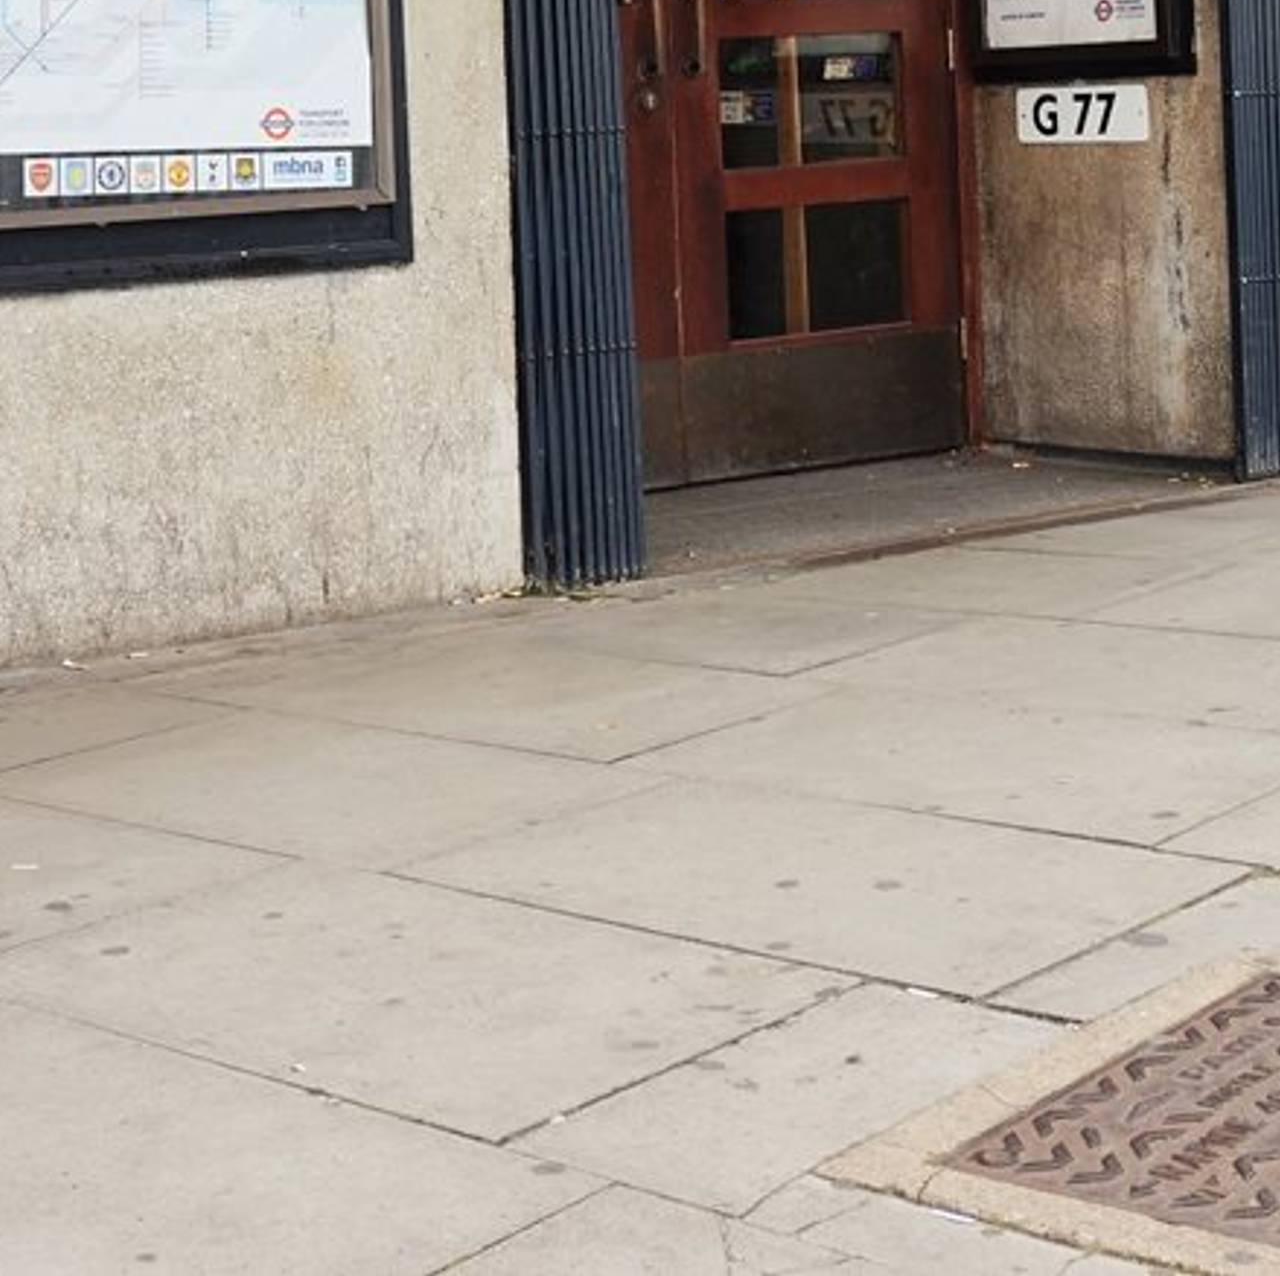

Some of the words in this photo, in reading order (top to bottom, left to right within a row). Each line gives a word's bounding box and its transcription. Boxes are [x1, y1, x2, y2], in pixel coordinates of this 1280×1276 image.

[1032, 93, 1059, 136] G
[1073, 92, 1117, 135] 77
[273, 156, 324, 175] mbna
